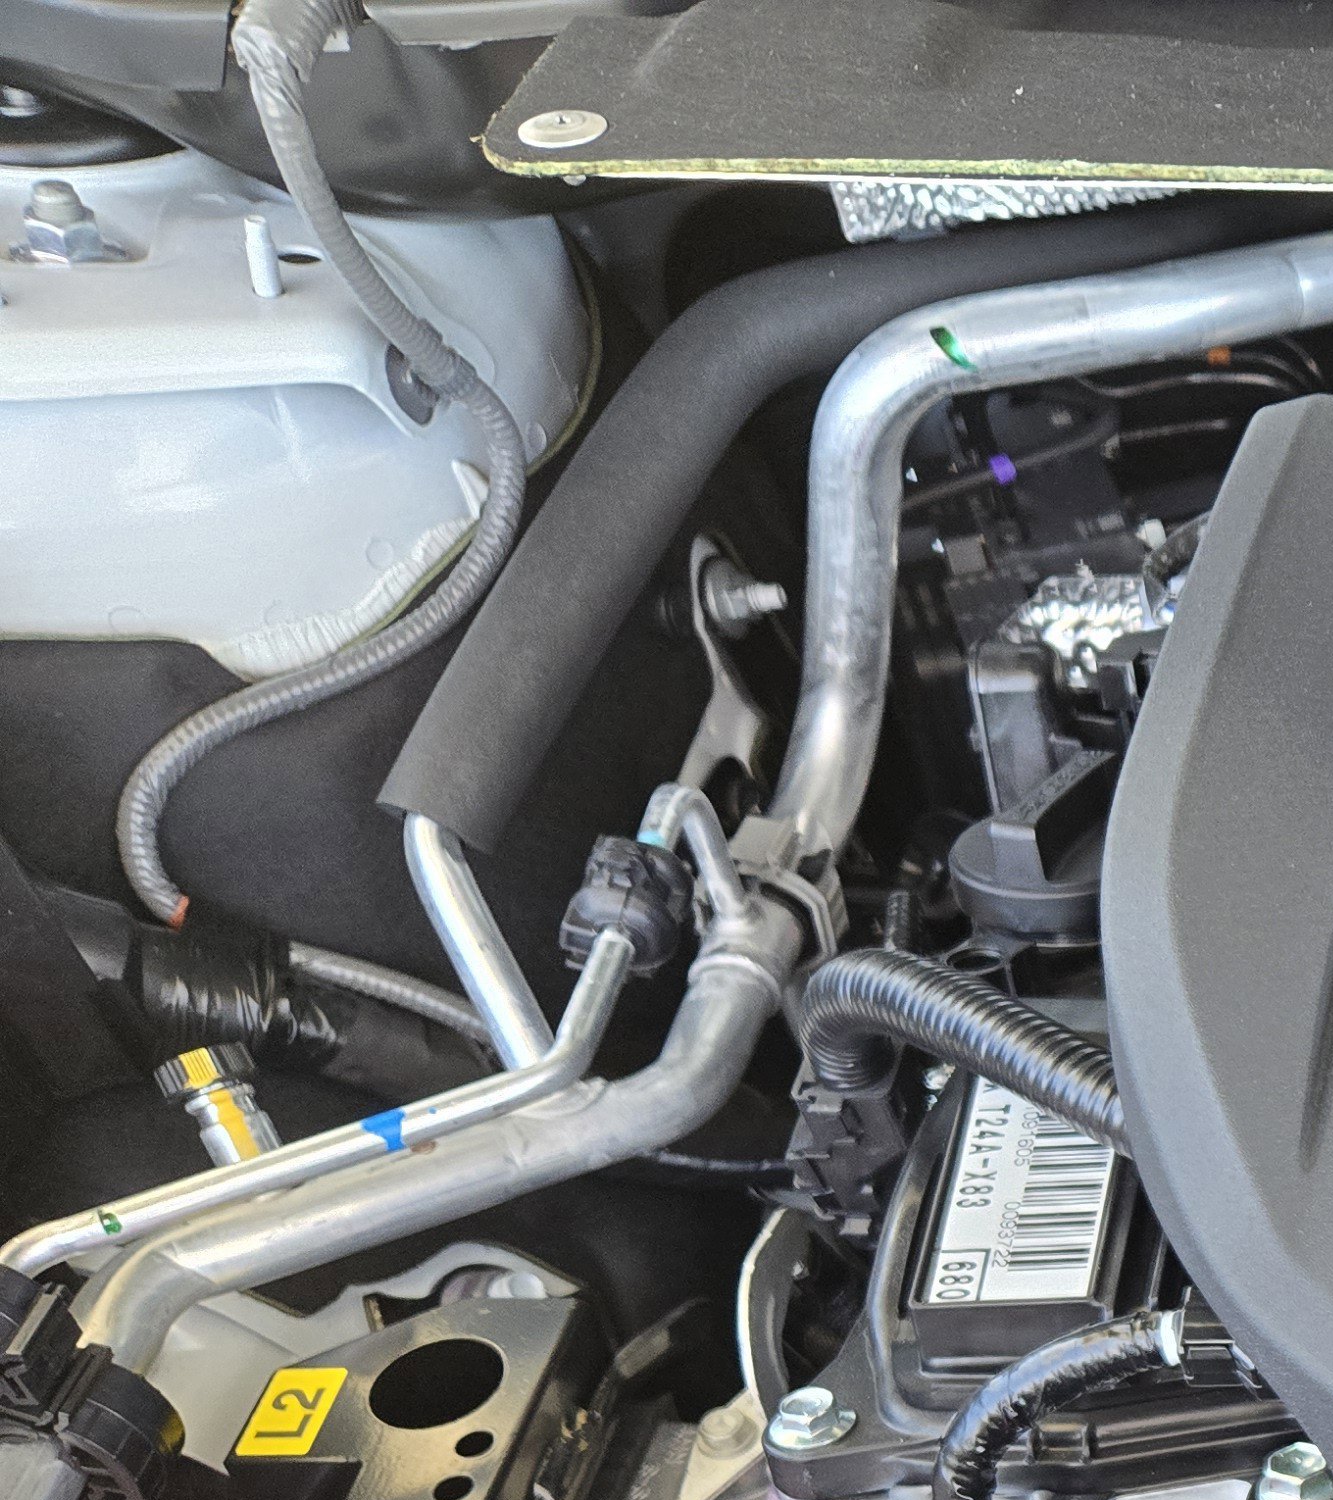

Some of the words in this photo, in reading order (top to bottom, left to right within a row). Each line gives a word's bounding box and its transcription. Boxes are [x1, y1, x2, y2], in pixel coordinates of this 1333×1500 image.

[956, 1104, 1011, 1209] T24A-X83
[991, 1201, 1022, 1269] 0093722
[936, 1261, 977, 1301] 680
[254, 1388, 325, 1438] L2
